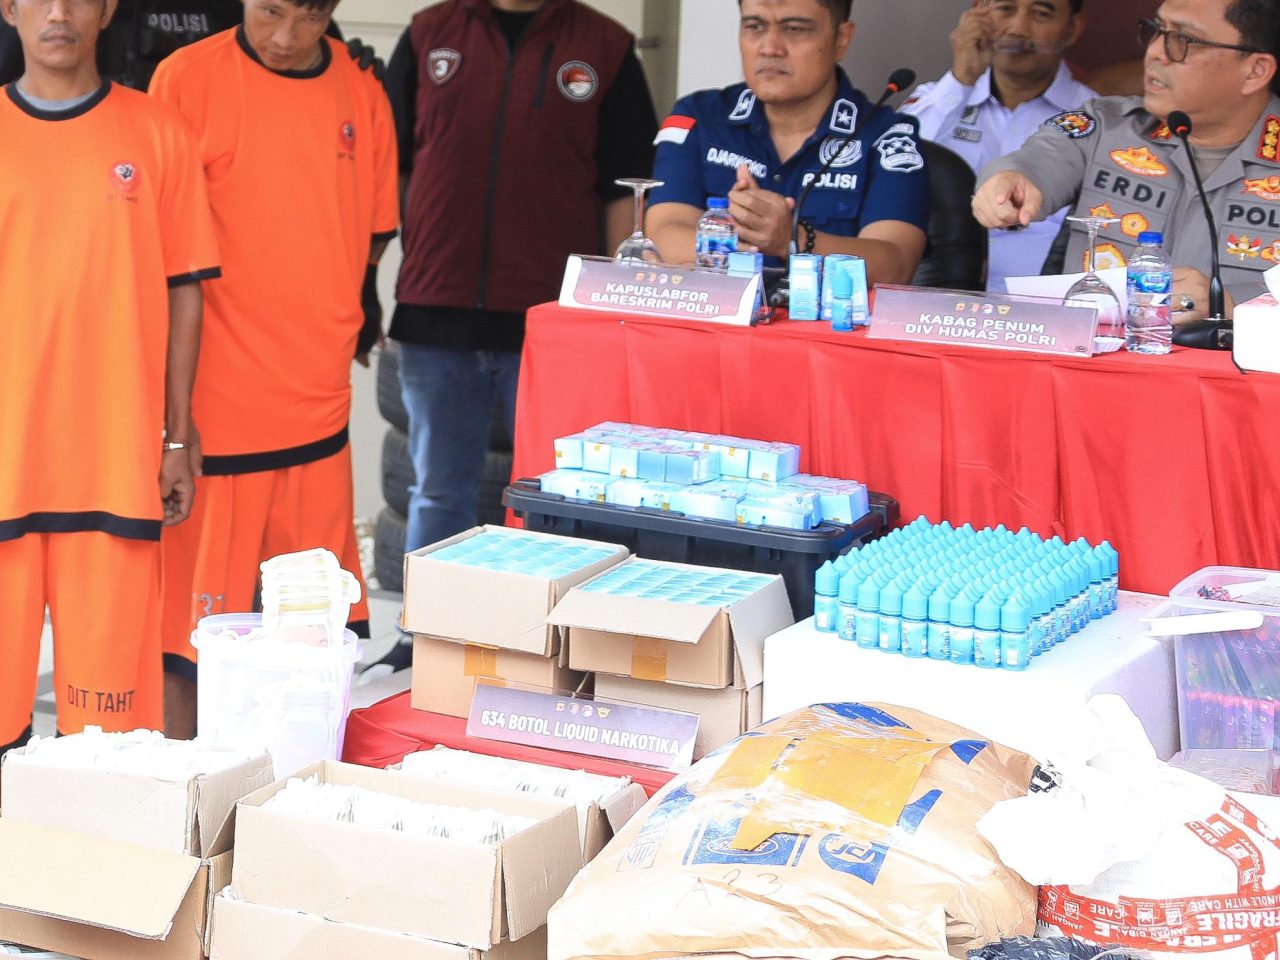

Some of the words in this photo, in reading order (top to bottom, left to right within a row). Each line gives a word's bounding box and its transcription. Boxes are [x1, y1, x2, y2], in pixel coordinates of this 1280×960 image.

[1093, 170, 1166, 208] ERDI
[1227, 204, 1280, 228] POL
[591, 292, 673, 310] BARESKRIM
[676, 302, 720, 315] POLRI
[605, 282, 709, 302] KAPUSLABFOR
[905, 323, 933, 336] DIV
[938, 326, 999, 341] HUMAS
[1004, 334, 1056, 346] POLRI
[919, 313, 977, 328] KABAG
[982, 319, 1045, 334] PENUM
[68, 684, 89, 709] DIT
[481, 709, 506, 728] 634
[508, 716, 550, 736] BOTOL
[554, 721, 598, 744] LIQUID
[601, 729, 680, 756] NARKOTIKA
[1090, 903, 1122, 919] CARE
